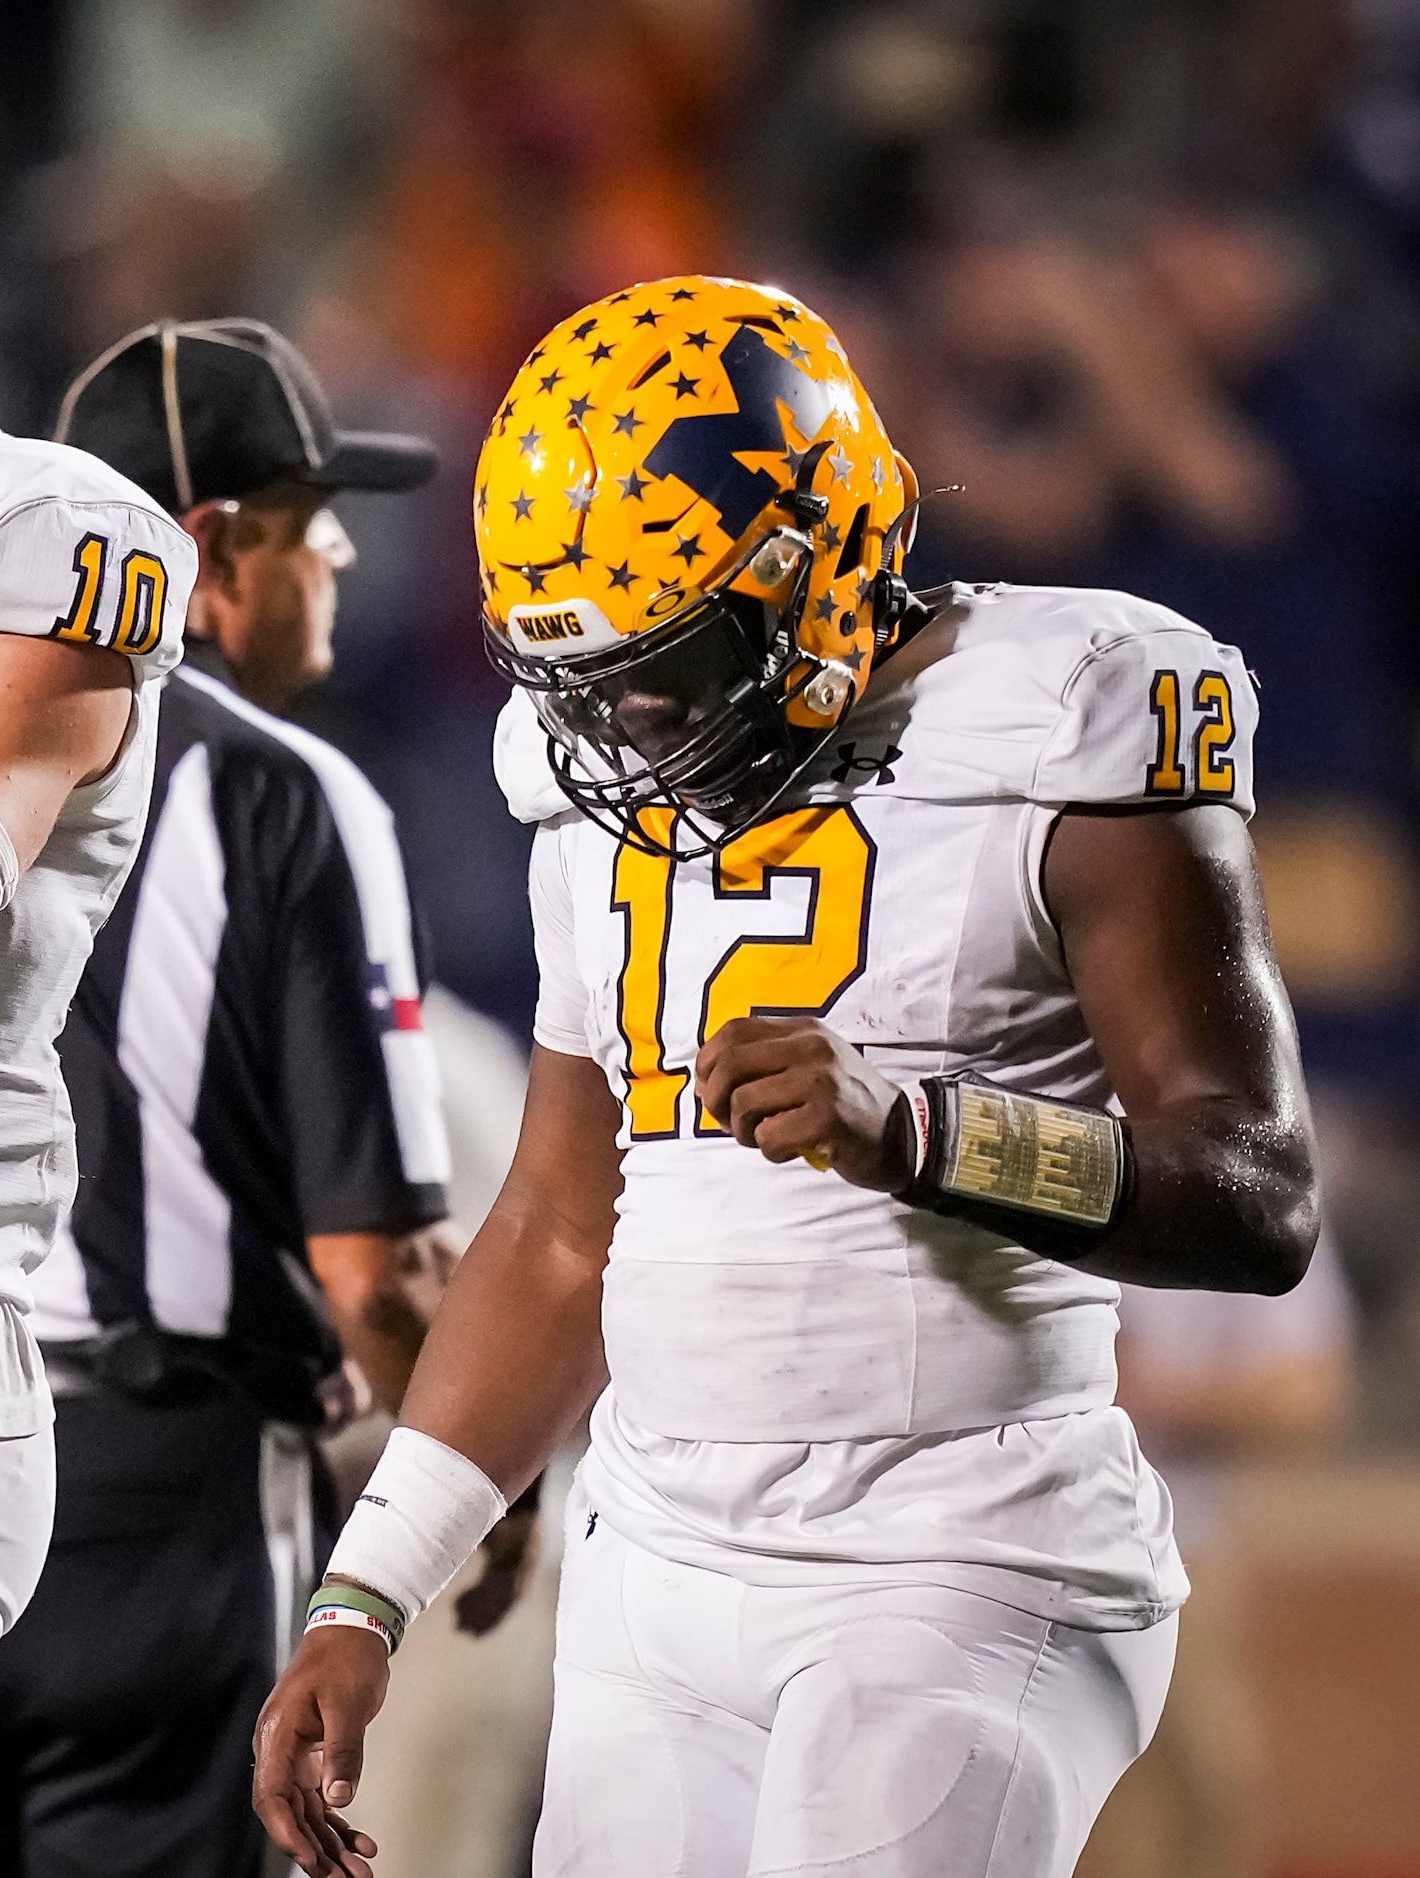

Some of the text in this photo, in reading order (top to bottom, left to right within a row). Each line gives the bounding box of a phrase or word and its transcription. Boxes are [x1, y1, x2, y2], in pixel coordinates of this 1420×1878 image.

[47, 531, 170, 656] 10
[516, 611, 585, 642] WAWG
[1144, 669, 1236, 798] 12
[610, 802, 877, 1141] 12
